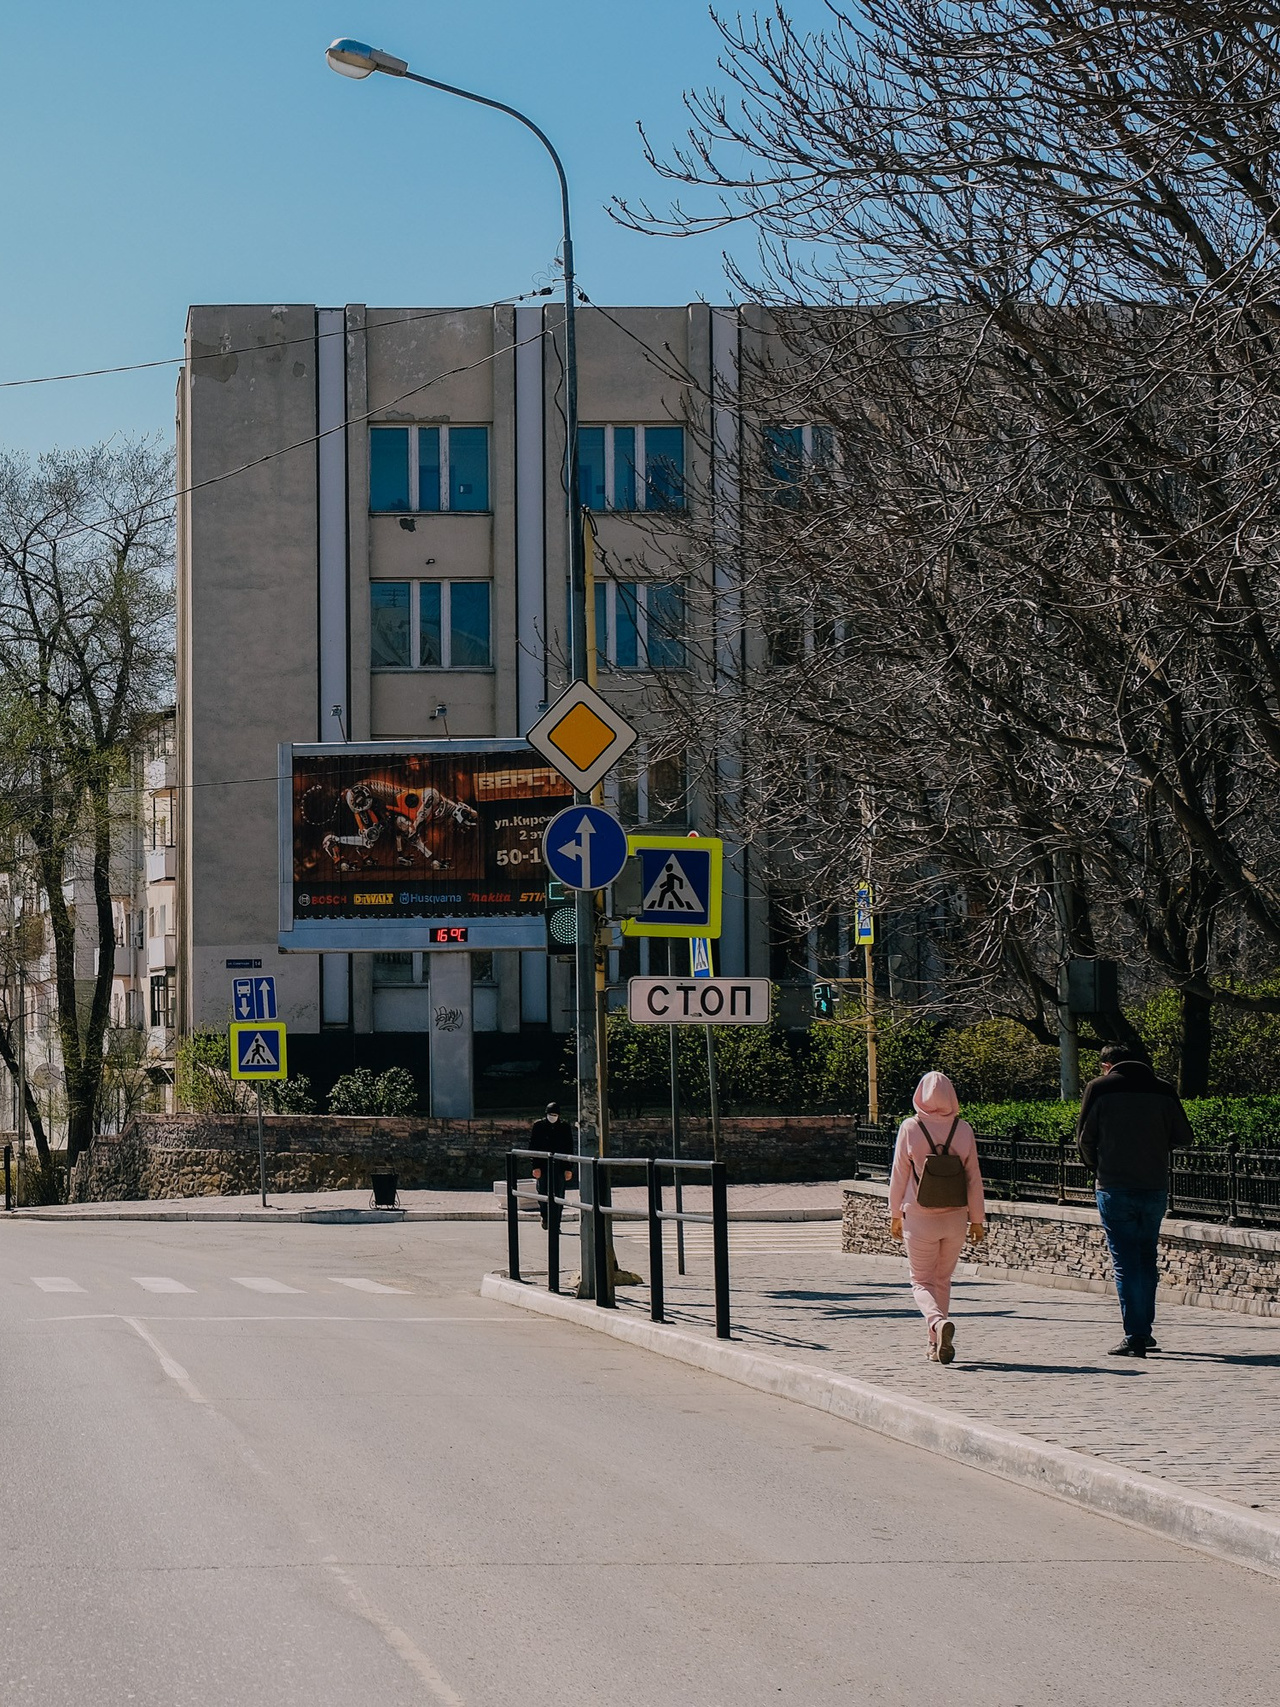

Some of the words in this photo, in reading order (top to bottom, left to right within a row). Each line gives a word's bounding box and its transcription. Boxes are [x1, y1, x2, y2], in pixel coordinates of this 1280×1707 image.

[519, 830, 528, 841] 2
[311, 895, 348, 905] BOSCH
[410, 893, 462, 905] Husqvarna
[437, 929, 448, 942] 16
[814, 986, 831, 1000] 21
[647, 985, 751, 1016] СТОП
